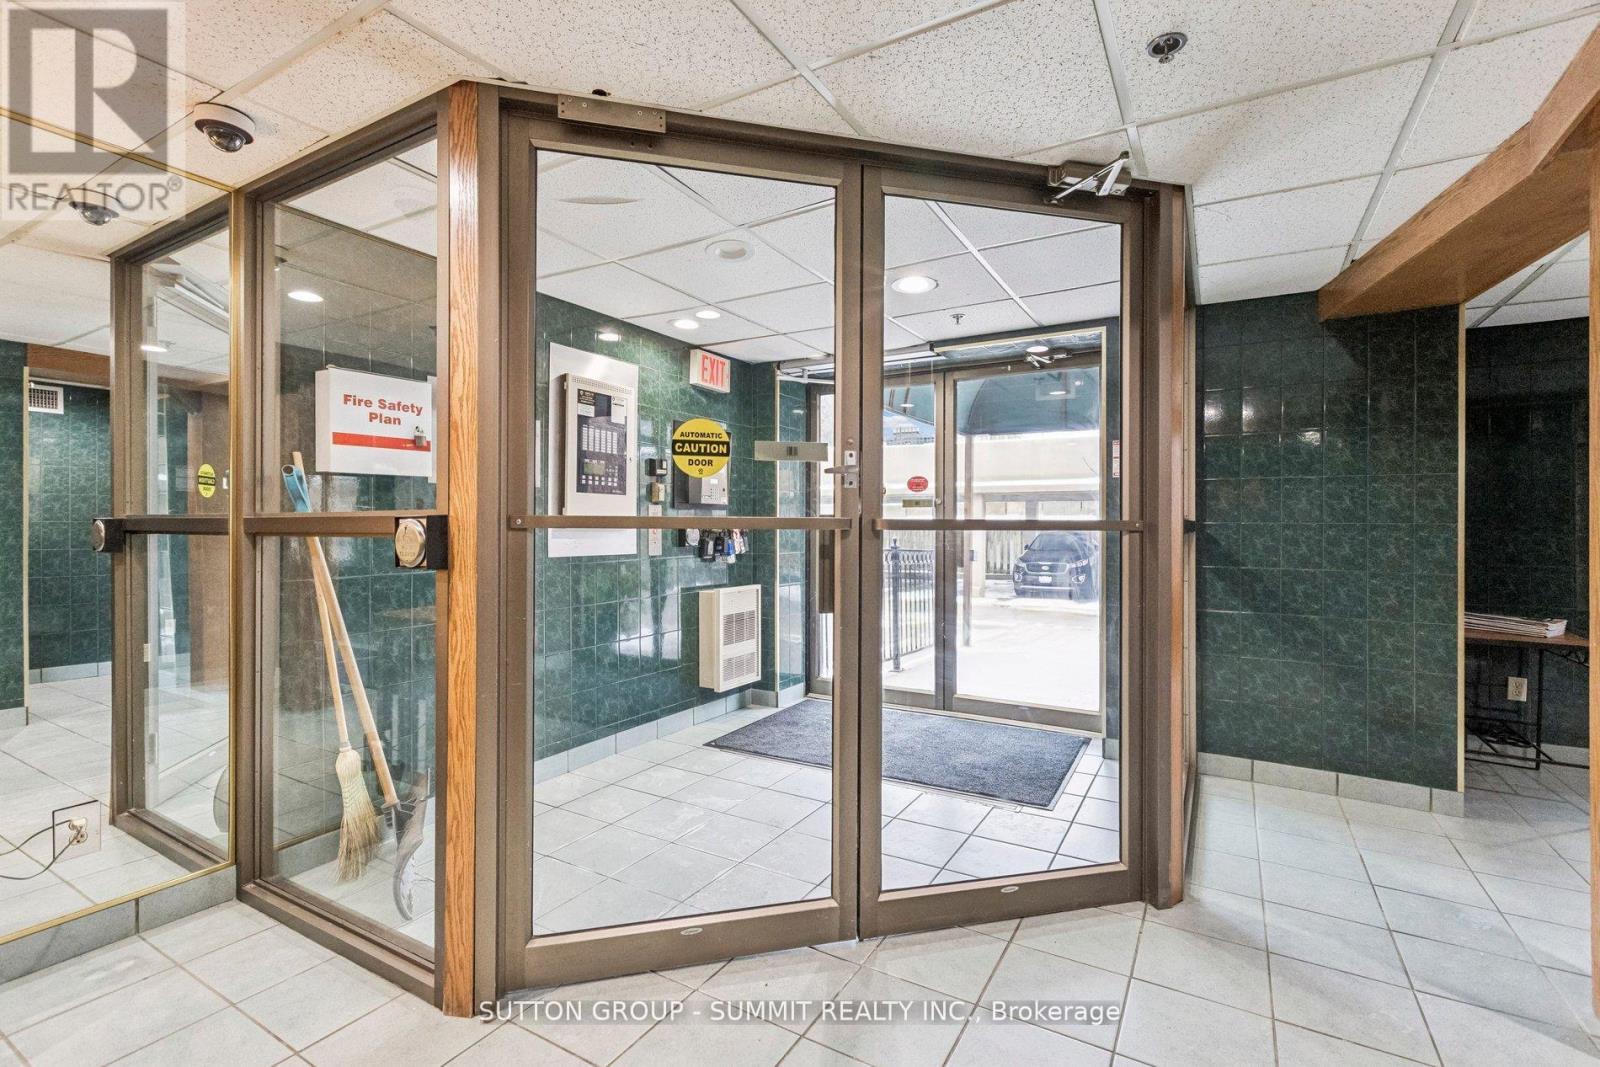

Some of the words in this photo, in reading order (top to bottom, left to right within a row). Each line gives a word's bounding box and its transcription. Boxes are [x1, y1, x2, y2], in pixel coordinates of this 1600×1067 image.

[701, 353, 726, 387] EXIT
[343, 393, 373, 408] Fire
[377, 398, 423, 417] Safety
[368, 412, 401, 426] Plan
[680, 431, 723, 439] AUTOMATIC
[675, 442, 727, 454] CAUTION
[688, 459, 713, 467] DOOR
